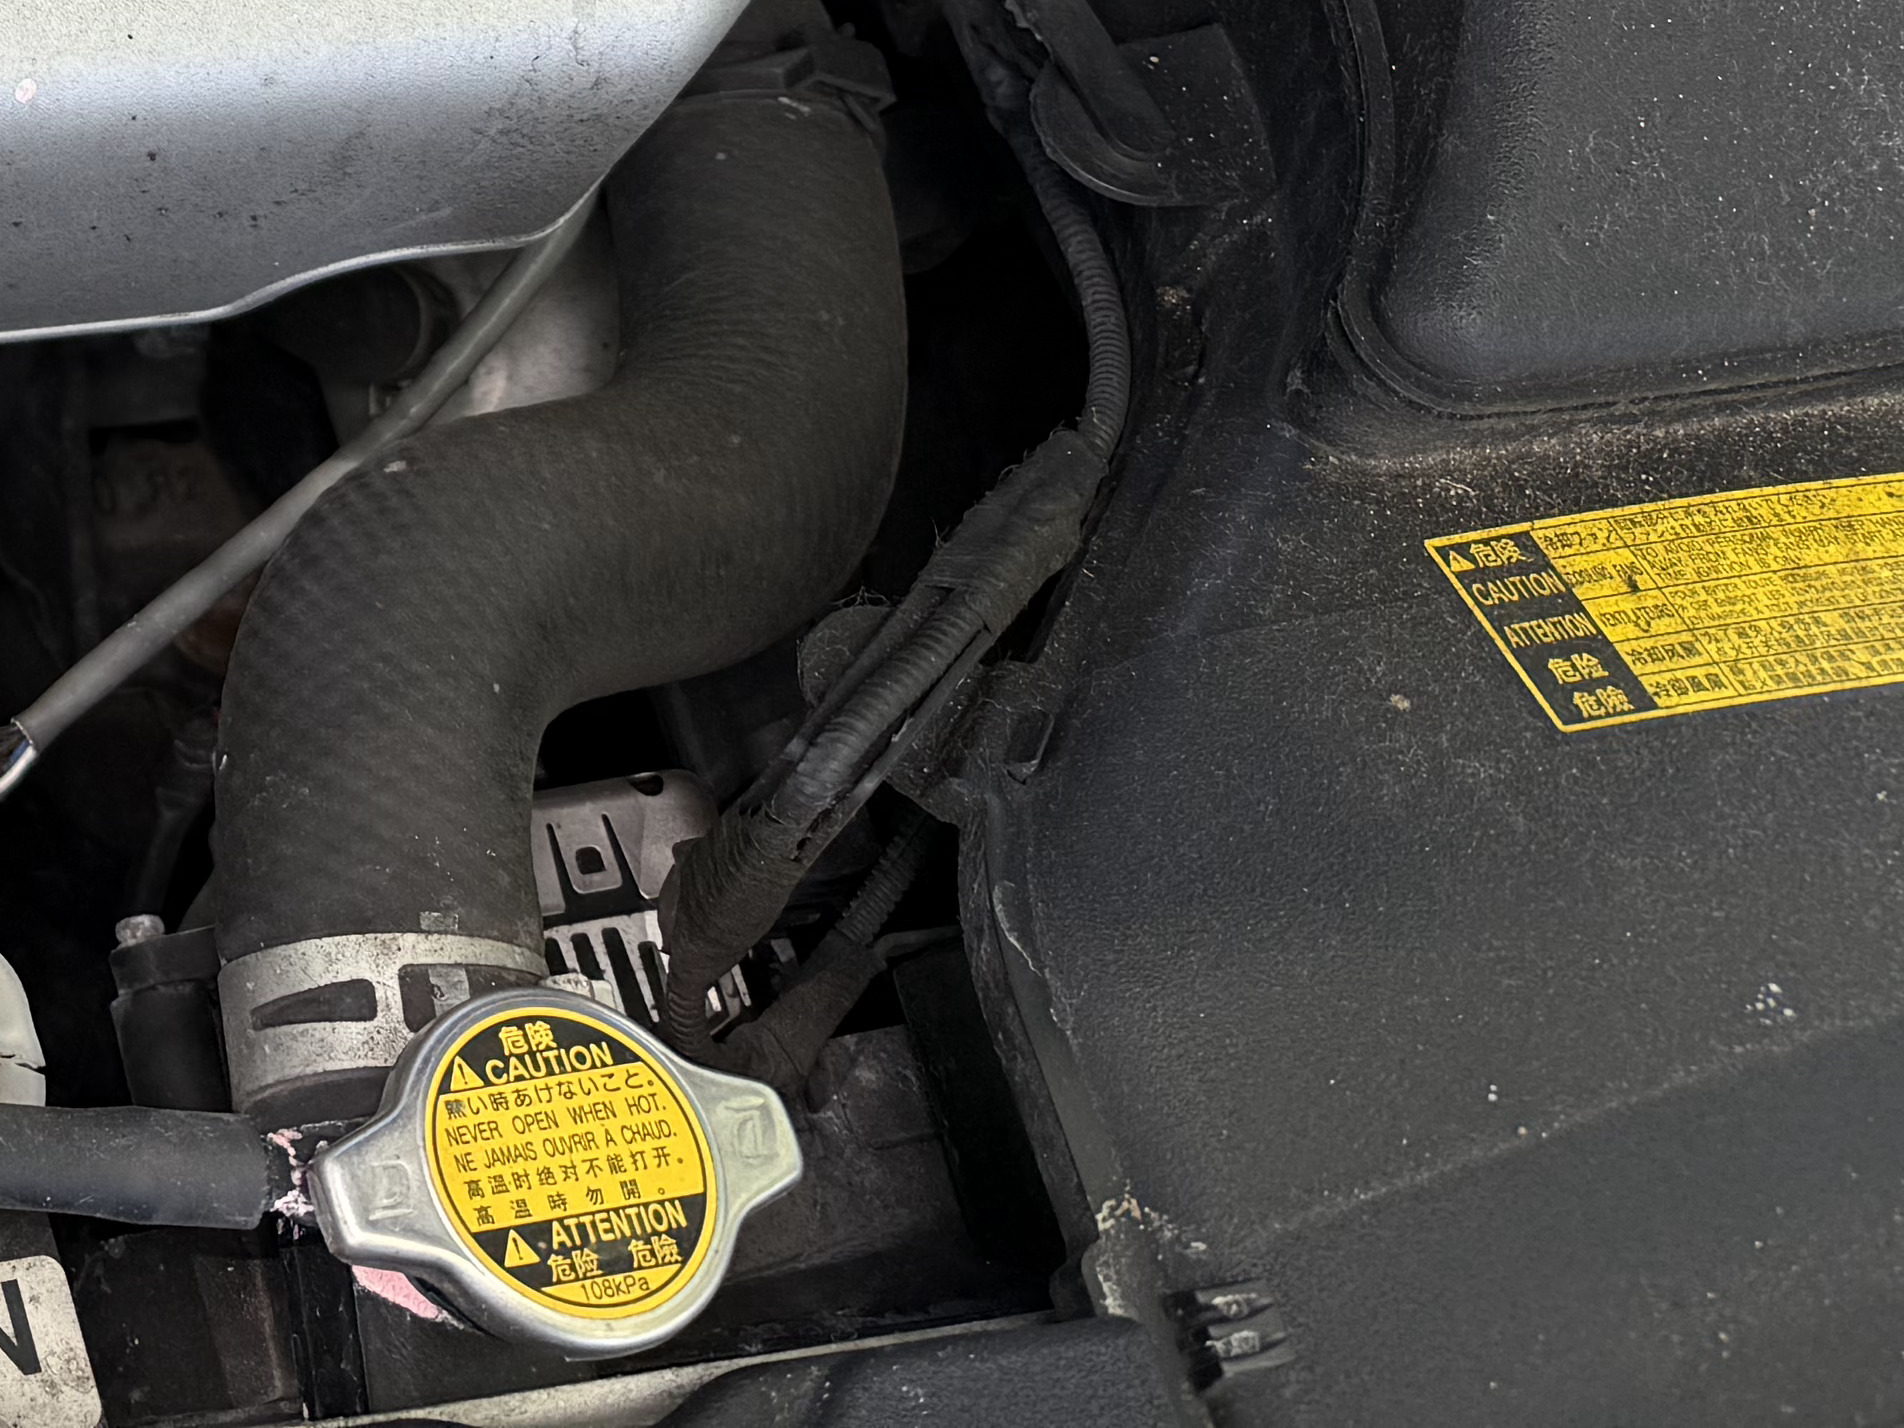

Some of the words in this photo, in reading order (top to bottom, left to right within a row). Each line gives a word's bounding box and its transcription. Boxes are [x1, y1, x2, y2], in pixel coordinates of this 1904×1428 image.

[1612, 561, 1644, 580] FANS
[1635, 546, 1658, 560] TO
[1472, 570, 1567, 606] CAUTION
[1504, 612, 1598, 648] ATTENTION
[1548, 652, 1609, 685] 危险
[1573, 685, 1635, 718] 危險
[499, 1020, 557, 1056] 危険
[485, 1042, 614, 1085] CAUTION
[444, 1120, 503, 1148] NEVER
[511, 1109, 561, 1135] OPEN
[566, 1099, 617, 1126] WHEN
[624, 1092, 667, 1117] HOT.
[454, 1151, 479, 1174] NE
[483, 1142, 538, 1169] JAMAIS
[541, 1130, 601, 1159] OUVRIR
[620, 1118, 678, 1146] CHAUD.
[551, 1199, 688, 1250] ATTENTION
[547, 1247, 604, 1283] 危险
[627, 1234, 684, 1269] 危險
[580, 1273, 651, 1303] 108kPa
